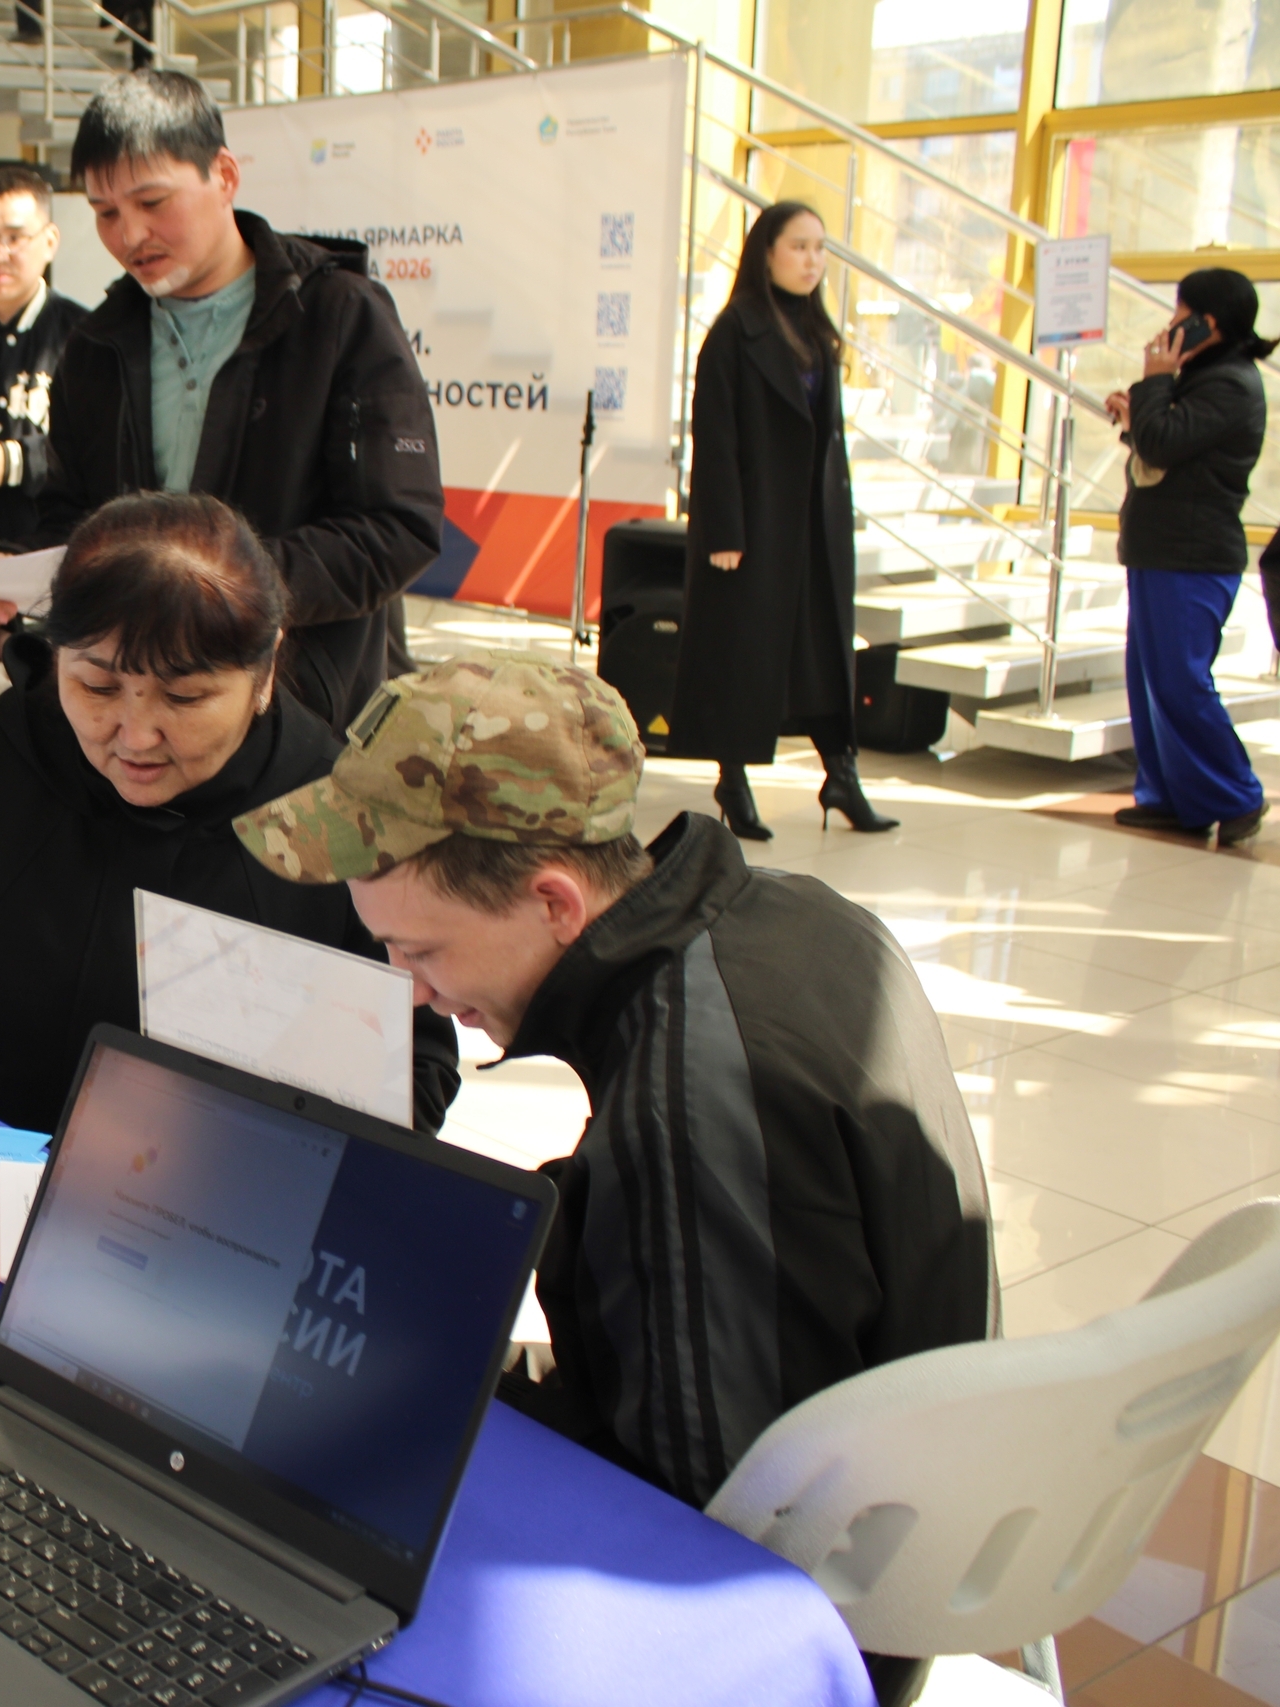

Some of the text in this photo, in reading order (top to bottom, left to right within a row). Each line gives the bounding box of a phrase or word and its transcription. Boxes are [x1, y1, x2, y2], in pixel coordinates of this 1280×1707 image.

[364, 223, 463, 247] ЯРМАРКА
[385, 257, 433, 280] 2026
[302, 1248, 366, 1315] ТА
[283, 1303, 367, 1376] ИИ
